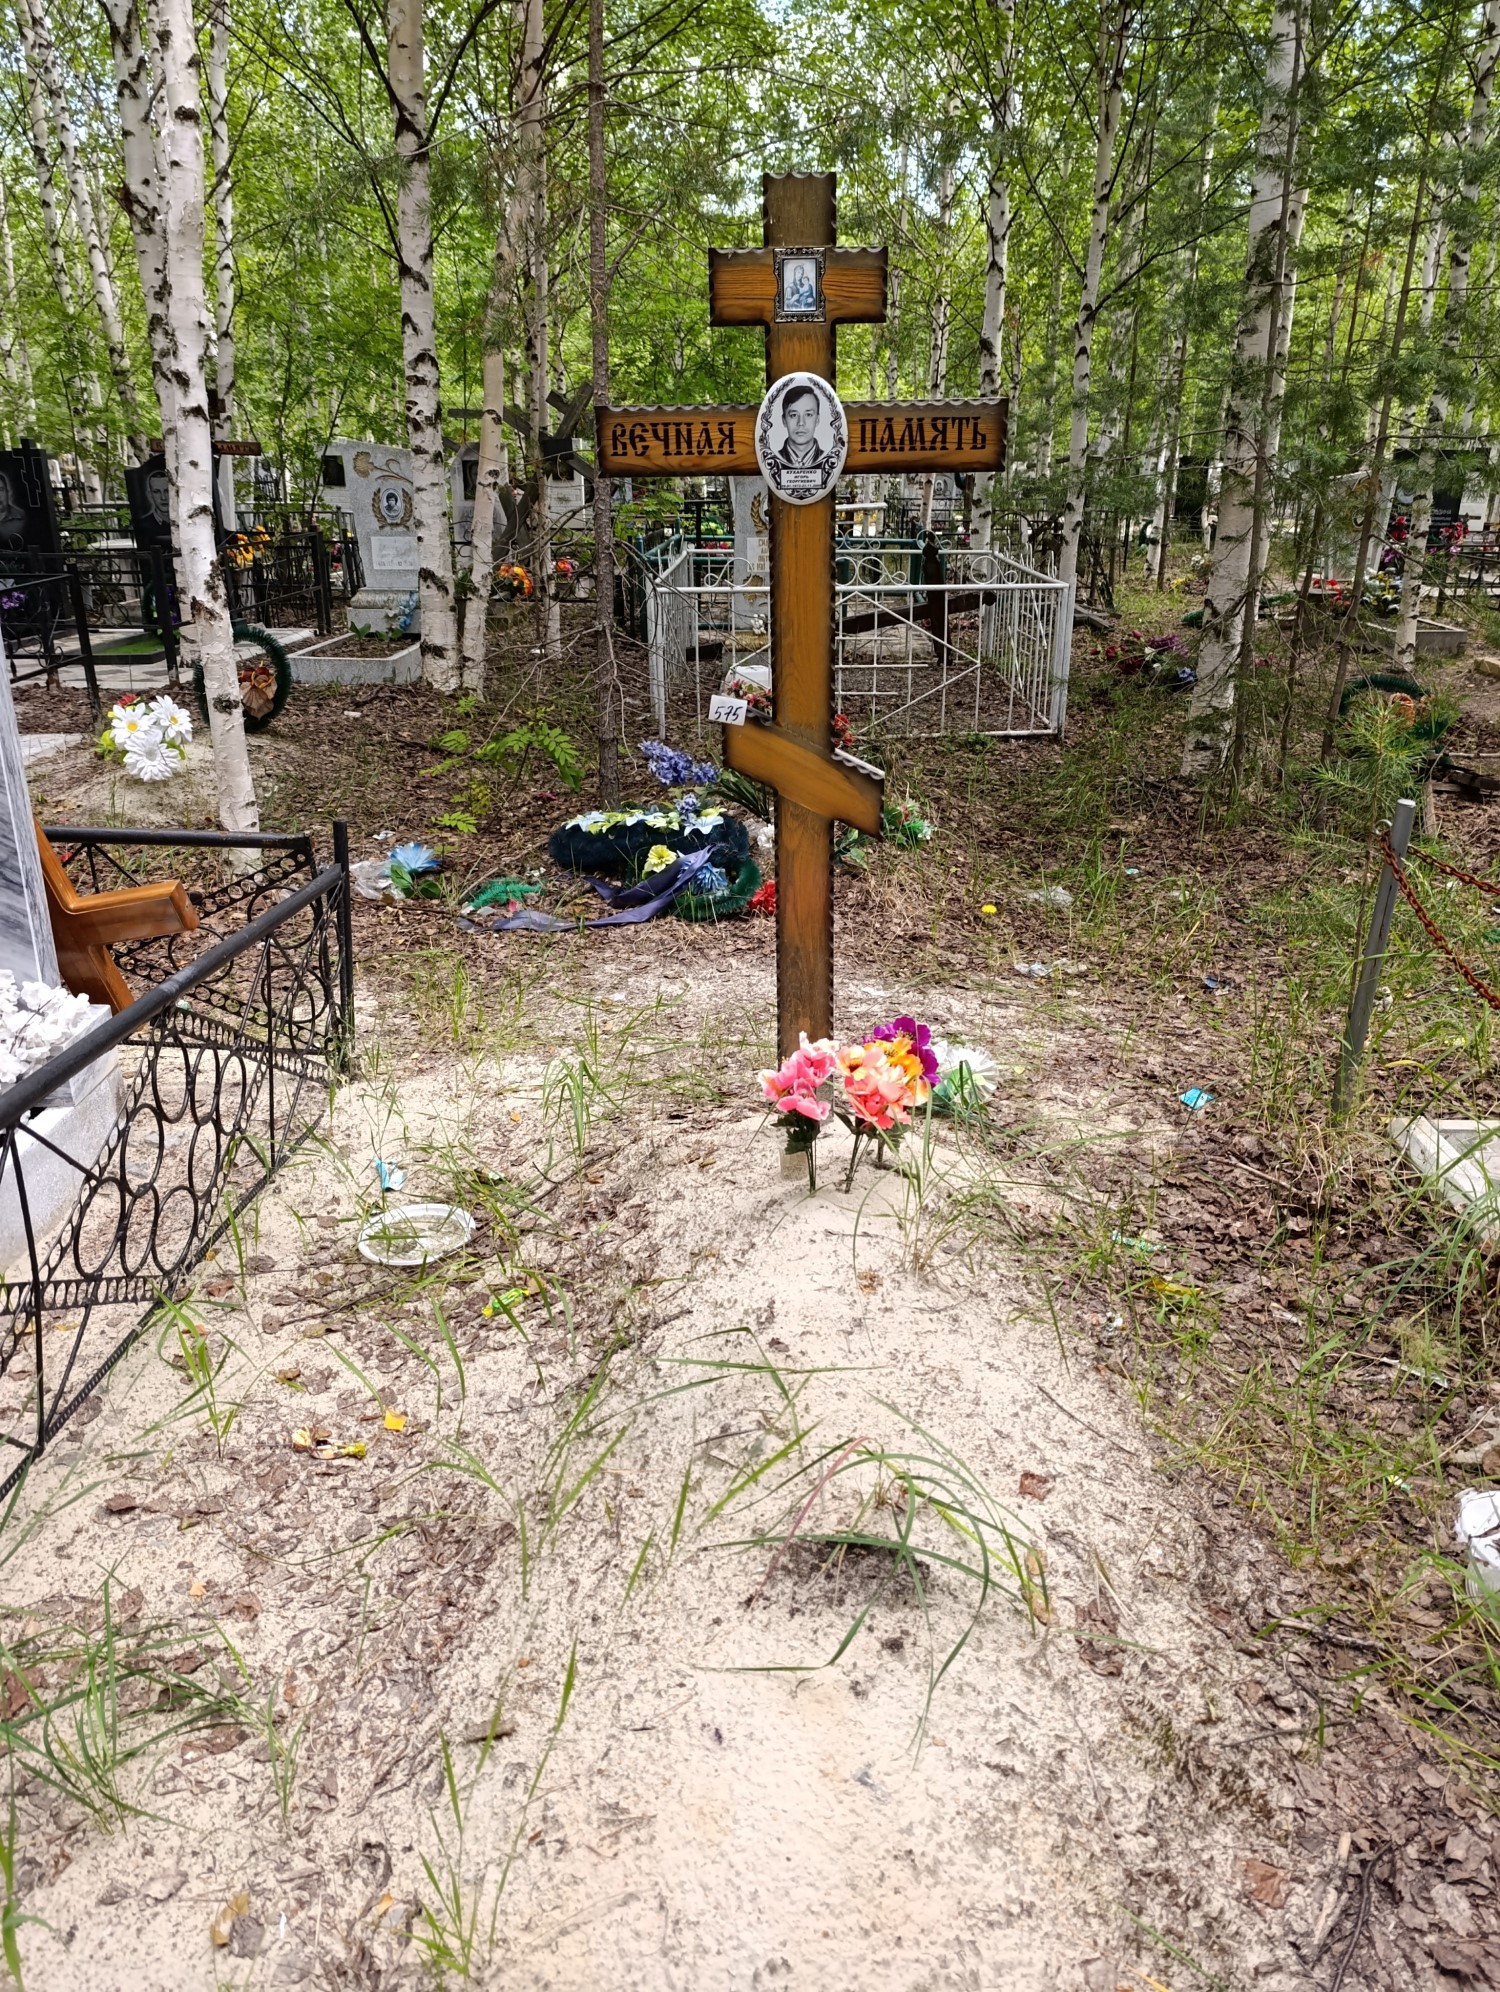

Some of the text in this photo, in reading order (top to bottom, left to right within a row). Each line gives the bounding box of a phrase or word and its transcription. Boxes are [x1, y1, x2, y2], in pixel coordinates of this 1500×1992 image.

[610, 416, 987, 457] ВЕЧНАЯ ПАМЯТЬ
[715, 705, 744, 722] 575
